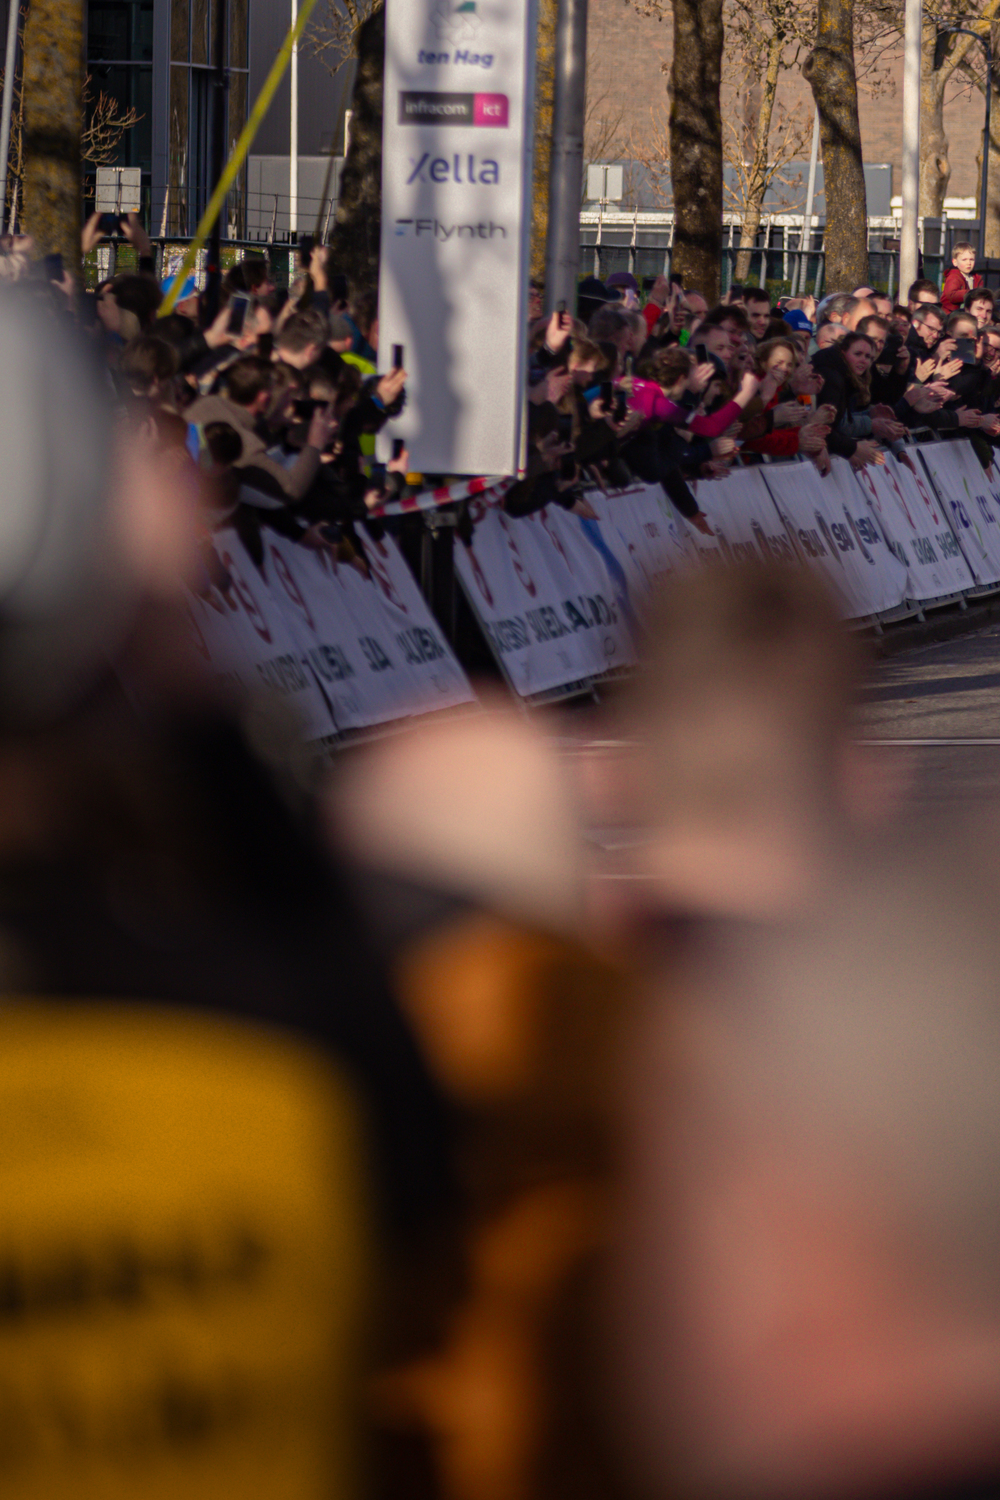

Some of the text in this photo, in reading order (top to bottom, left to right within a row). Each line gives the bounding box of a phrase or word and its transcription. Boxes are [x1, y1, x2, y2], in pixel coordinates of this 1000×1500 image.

[418, 49, 494, 69] ten Hag
[405, 101, 502, 117] infracom ict
[407, 152, 500, 185] Xella
[415, 219, 507, 242] Flynth
